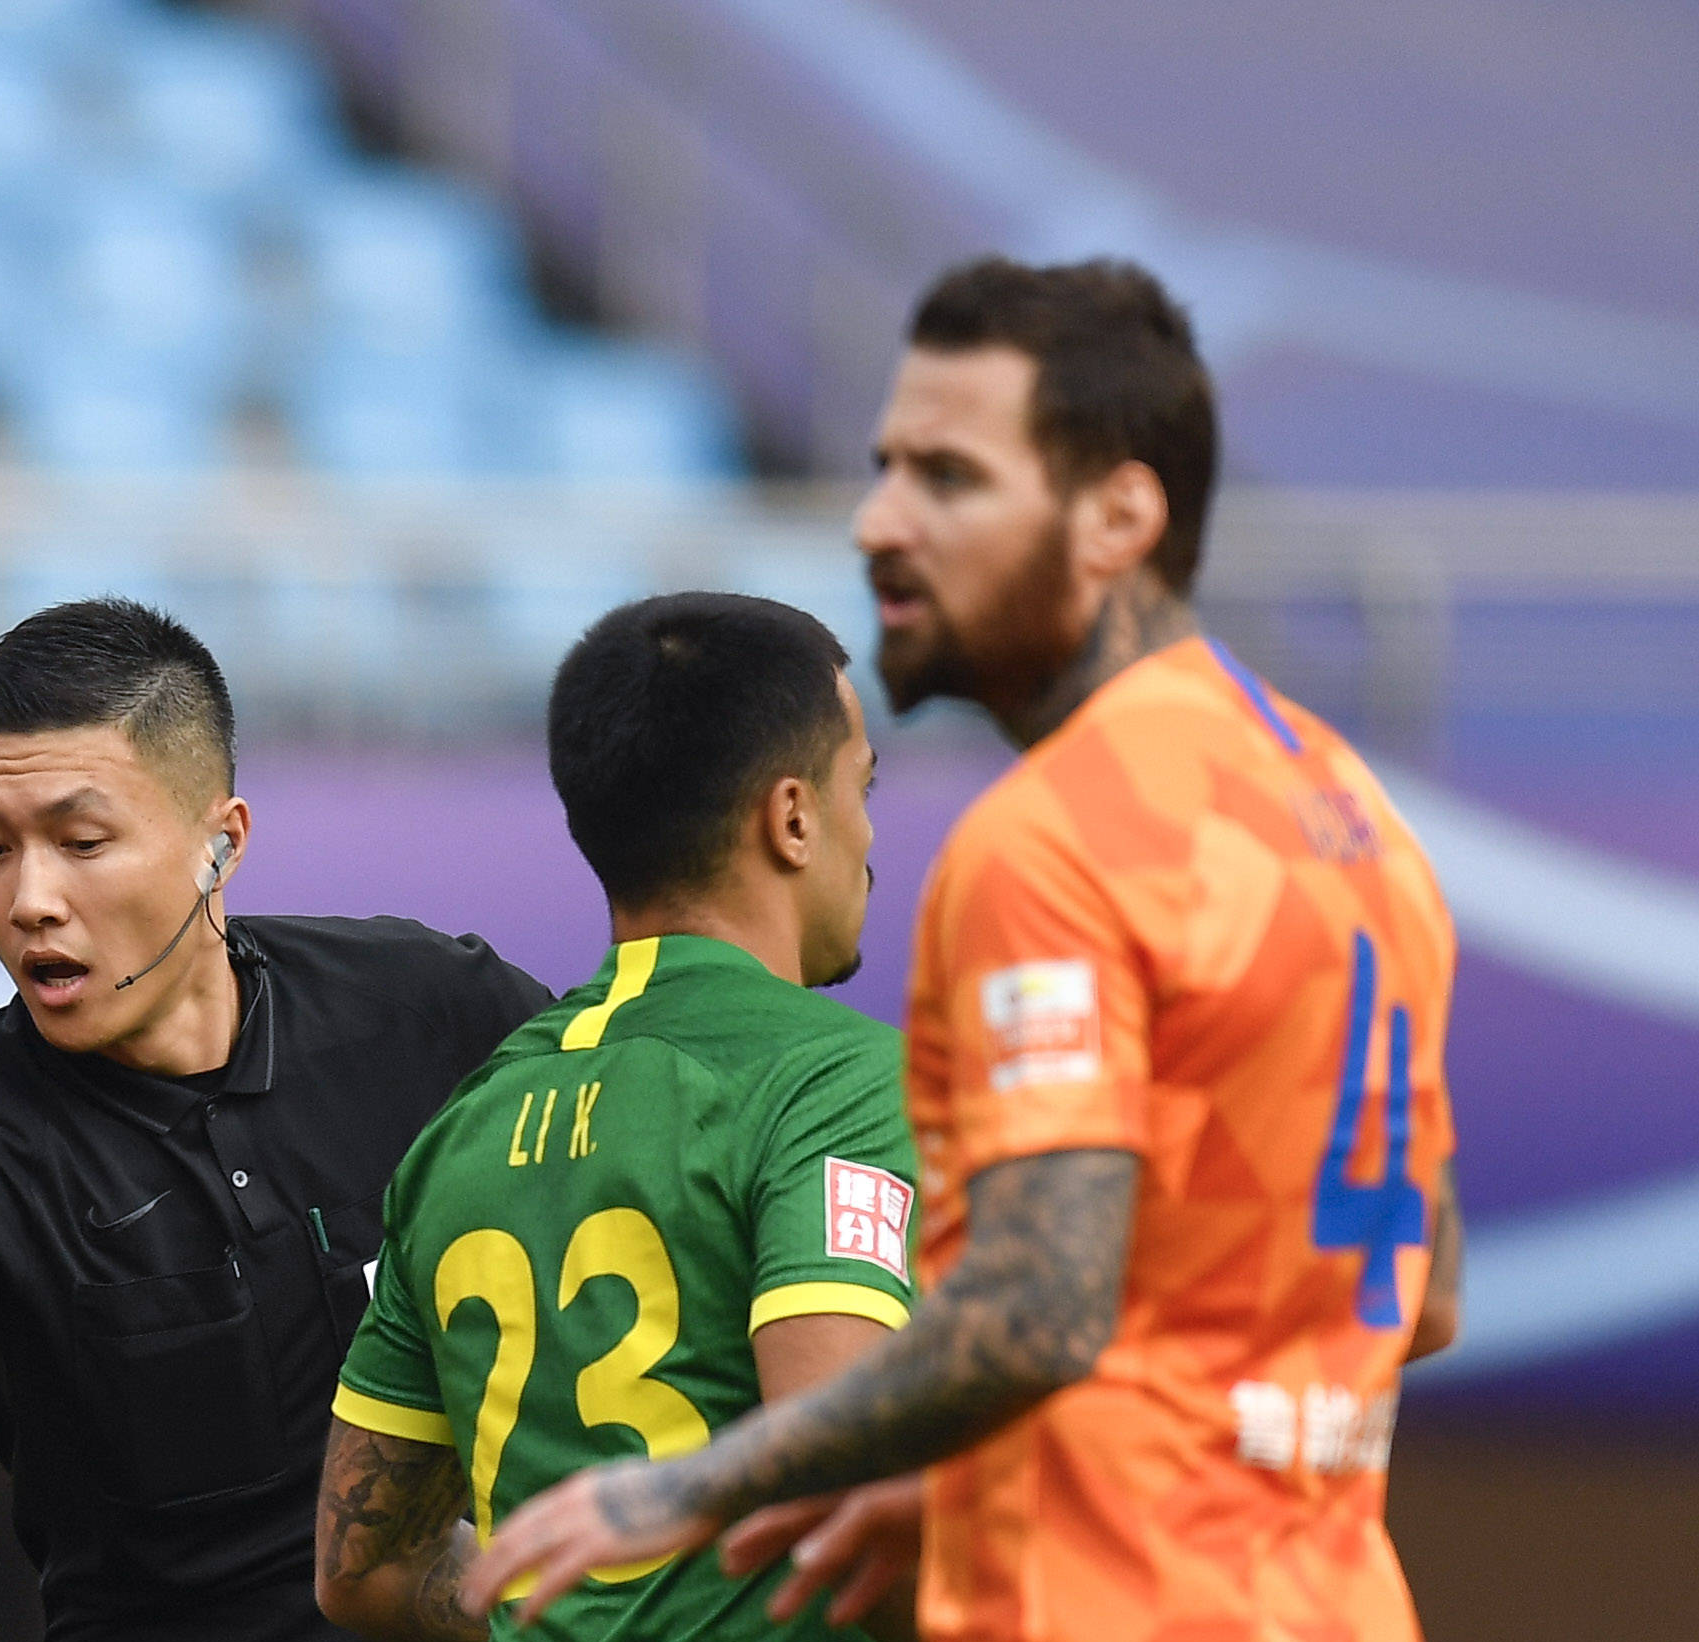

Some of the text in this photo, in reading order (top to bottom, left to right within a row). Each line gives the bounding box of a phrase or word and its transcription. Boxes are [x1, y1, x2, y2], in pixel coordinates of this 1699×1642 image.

[507, 1081, 602, 1167] LI K.
[1312, 930, 1428, 1328] 4
[433, 1206, 711, 1600] 23
